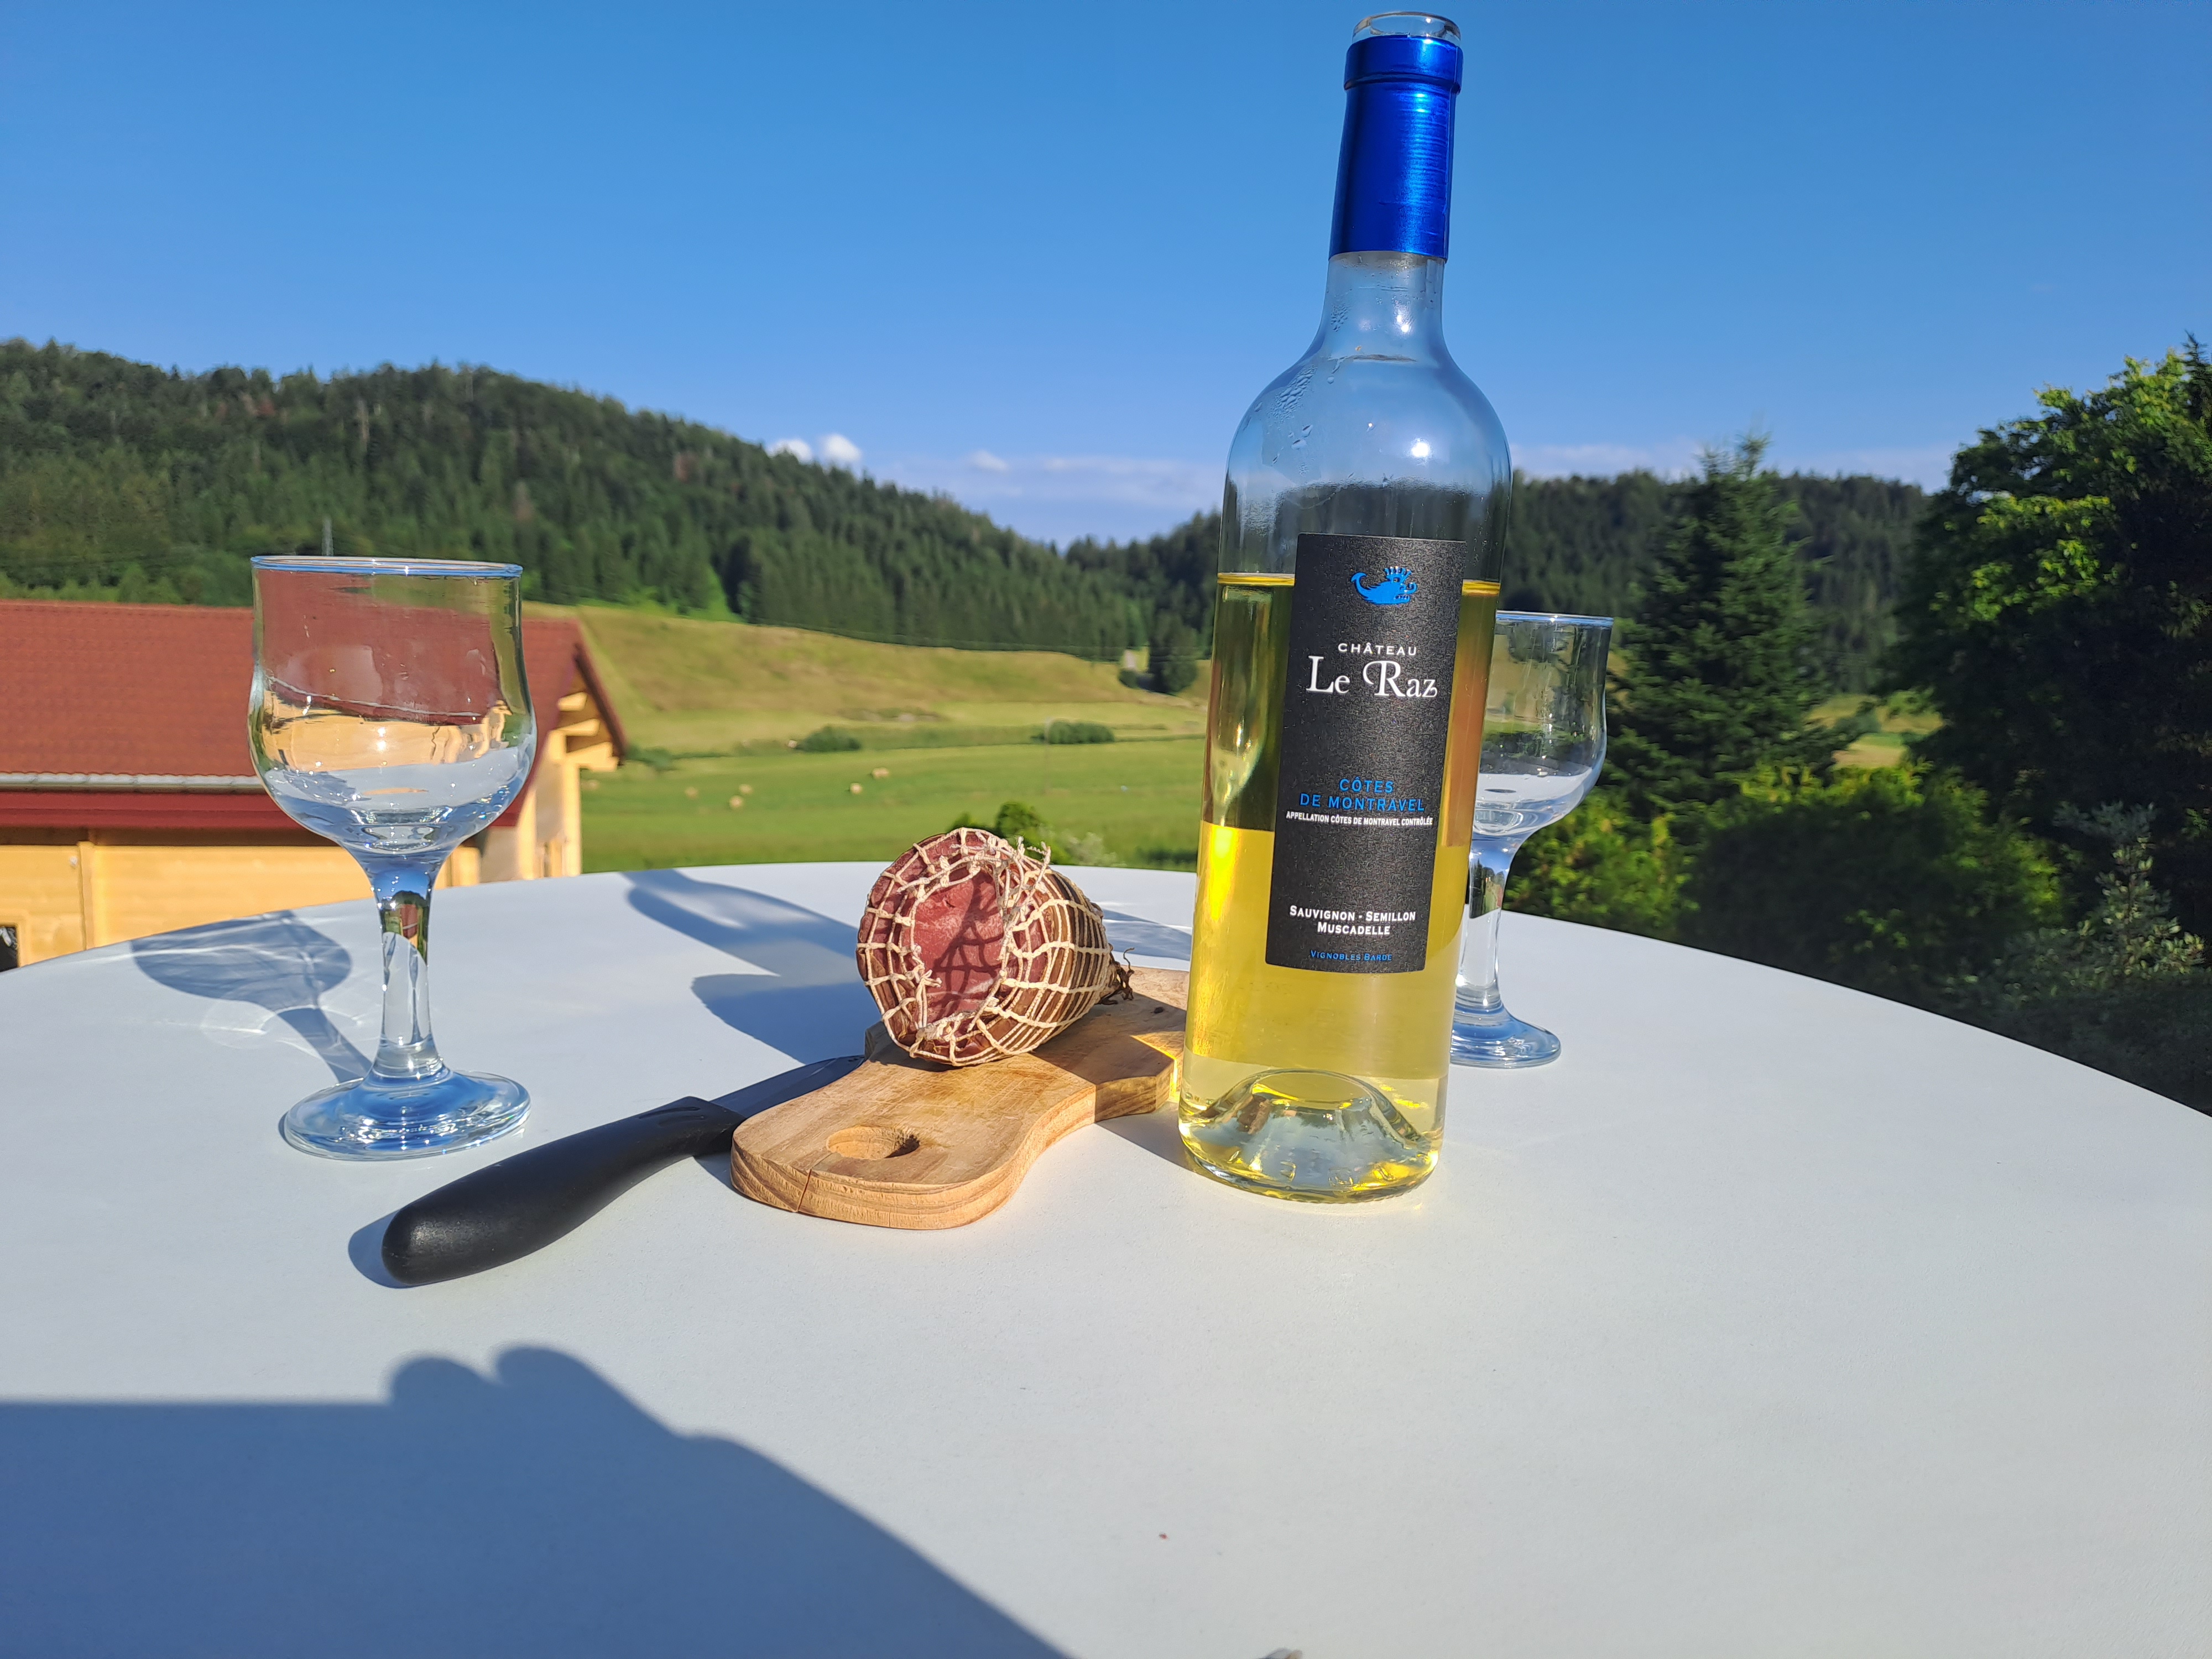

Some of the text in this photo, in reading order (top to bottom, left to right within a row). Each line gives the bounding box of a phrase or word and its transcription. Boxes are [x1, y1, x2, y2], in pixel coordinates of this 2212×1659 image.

[1338, 643, 1417, 656] CHÂTEAU
[1306, 656, 1437, 697] Le Raz
[1339, 776, 1394, 793] CÔTES
[1300, 793, 1425, 811] DE MONTRAVEL
[1286, 811, 1329, 823] APPELLATION
[1331, 814, 1352, 824] CÔTES
[1363, 817, 1400, 826] MONTRAVEL
[1401, 816, 1433, 826] CONTRÔLÉE
